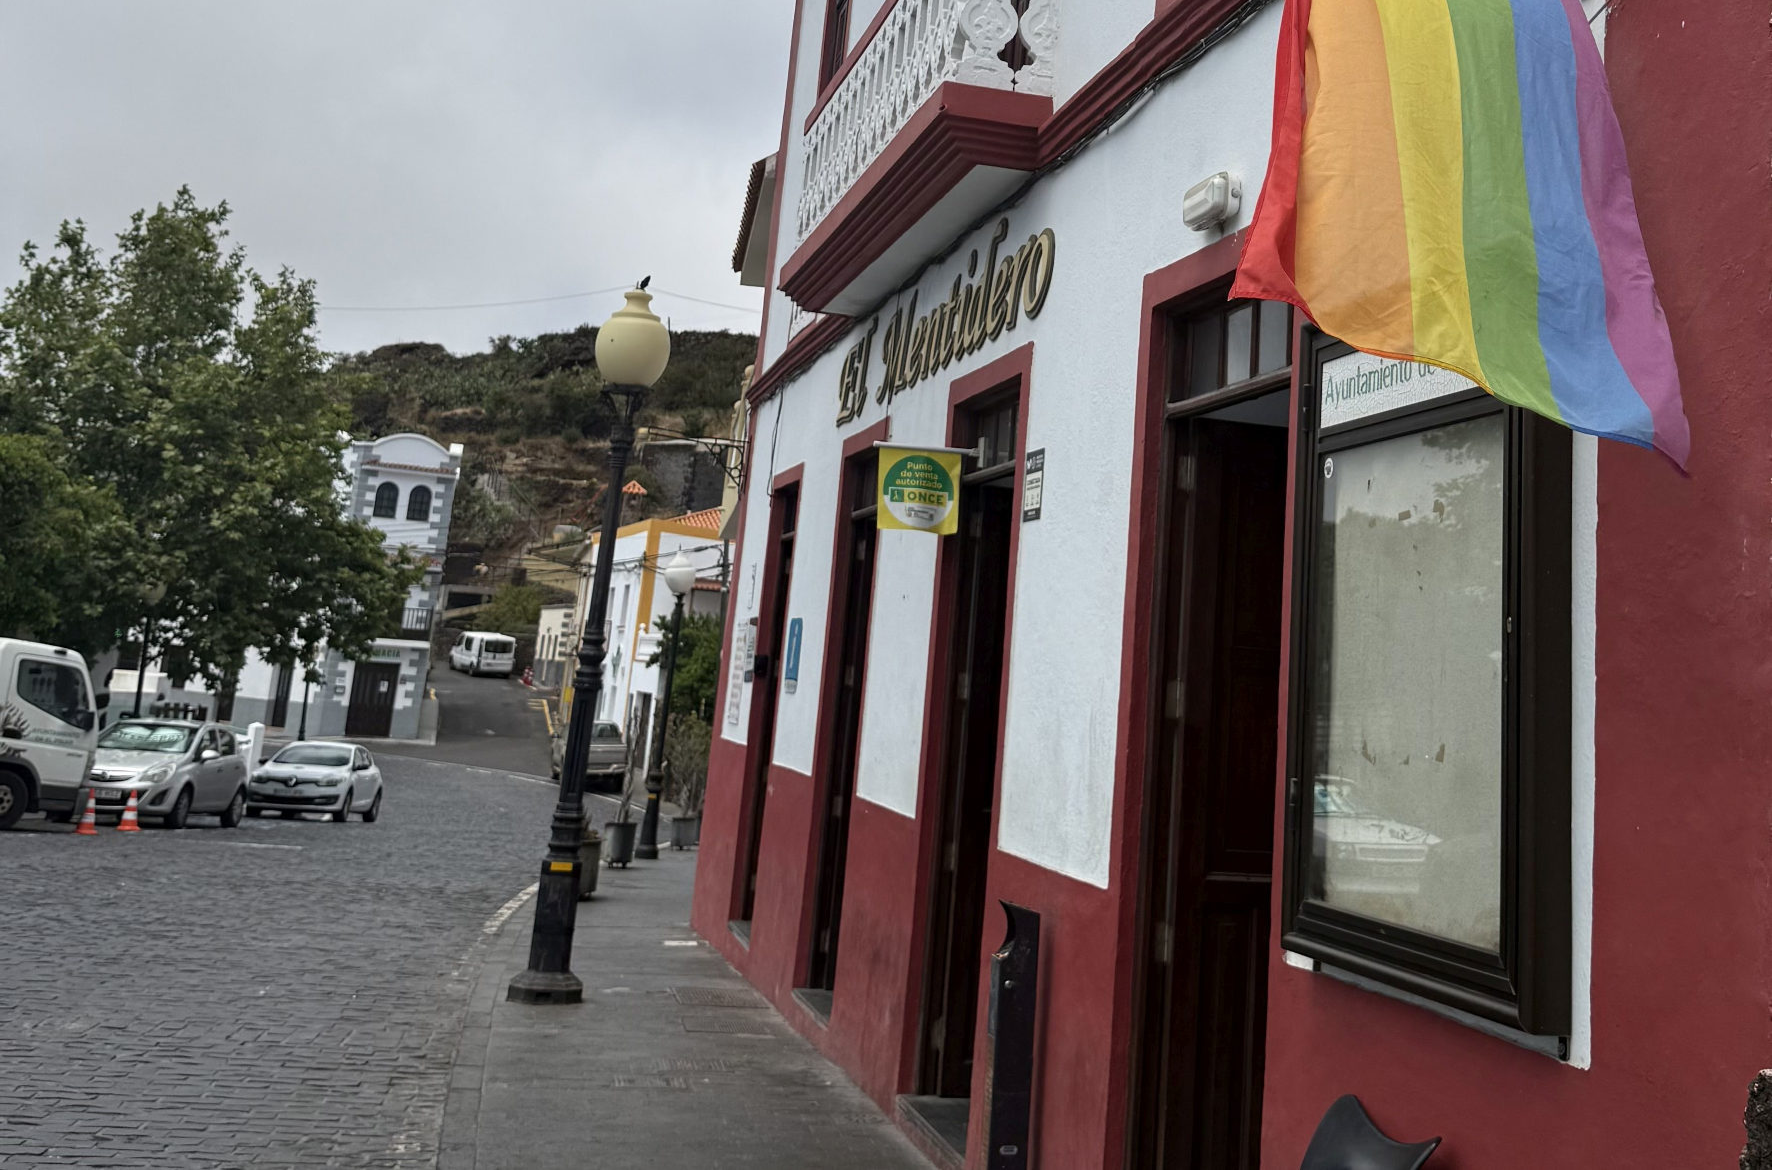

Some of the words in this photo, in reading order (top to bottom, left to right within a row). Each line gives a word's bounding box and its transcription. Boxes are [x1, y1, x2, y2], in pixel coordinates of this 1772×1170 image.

[836, 312, 879, 427] El
[875, 217, 1055, 405] Mentidero
[1325, 358, 1412, 409] Ayuntamiento
[906, 461, 933, 471] Punto
[900, 469, 912, 477] de
[913, 471, 938, 480] venta
[895, 478, 943, 489] autorizado
[907, 491, 944, 504] ONCE
